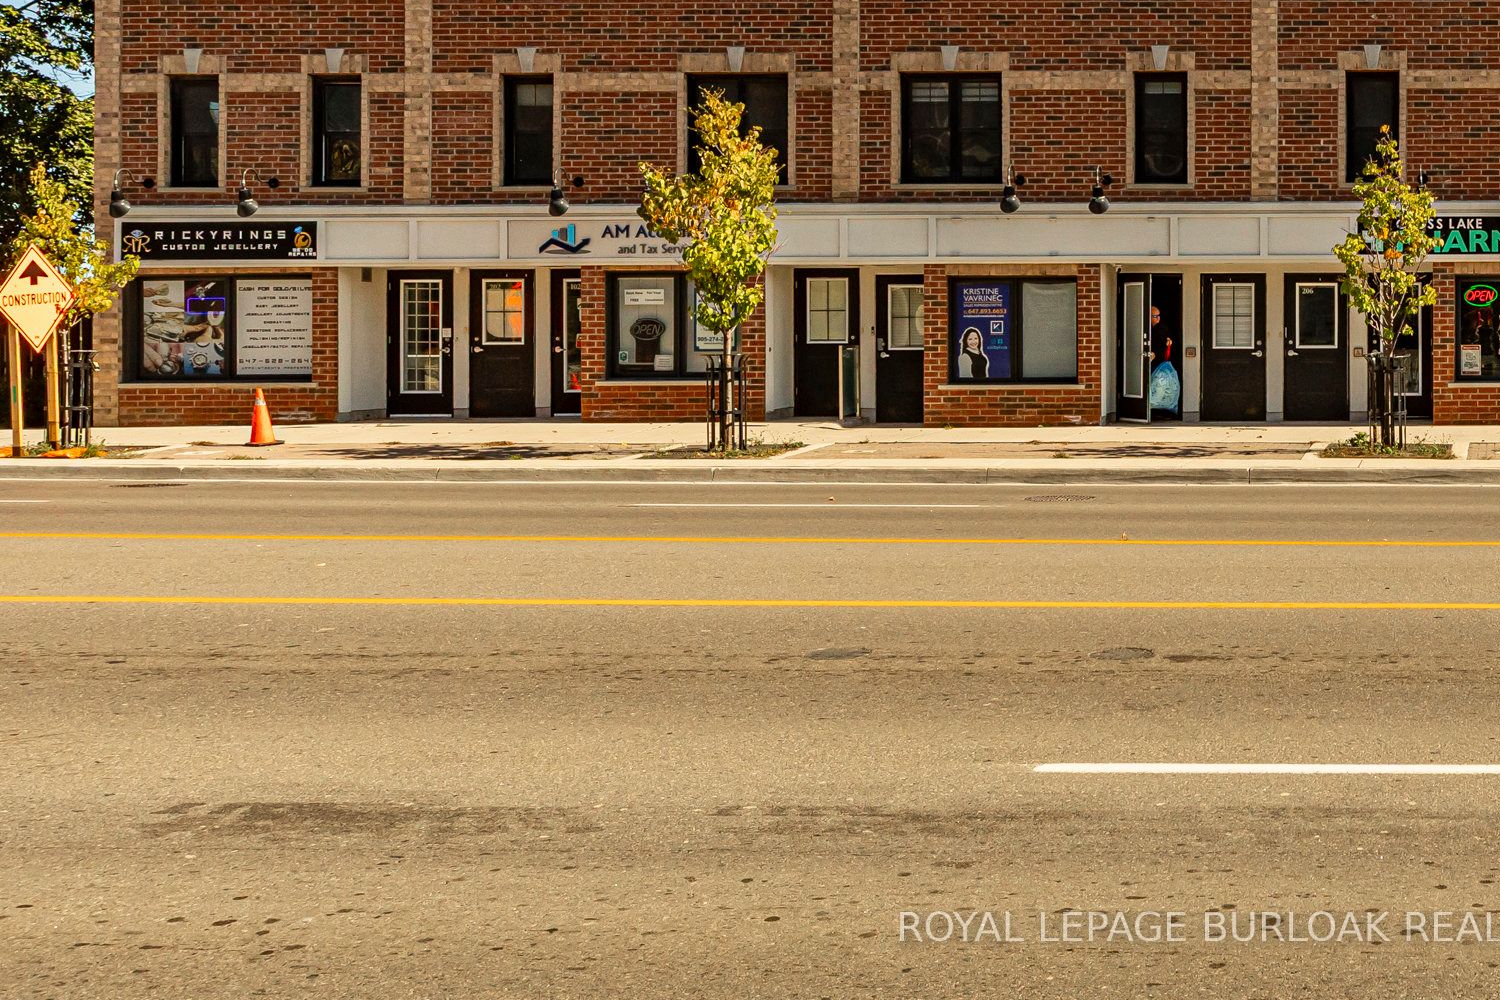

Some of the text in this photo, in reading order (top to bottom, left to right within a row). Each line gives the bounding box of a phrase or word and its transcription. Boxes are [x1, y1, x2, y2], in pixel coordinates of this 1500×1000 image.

[1449, 218, 1483, 229] LAKE
[155, 230, 287, 240] RICKYRINGS
[601, 224, 630, 238] AM
[618, 243, 636, 254] and
[639, 244, 658, 254] Tax
[1302, 287, 1314, 295] 206
[1465, 290, 1495, 302] OPEN
[2, 292, 67, 307] CONSTRUCTION
[633, 324, 660, 335] OPEN
